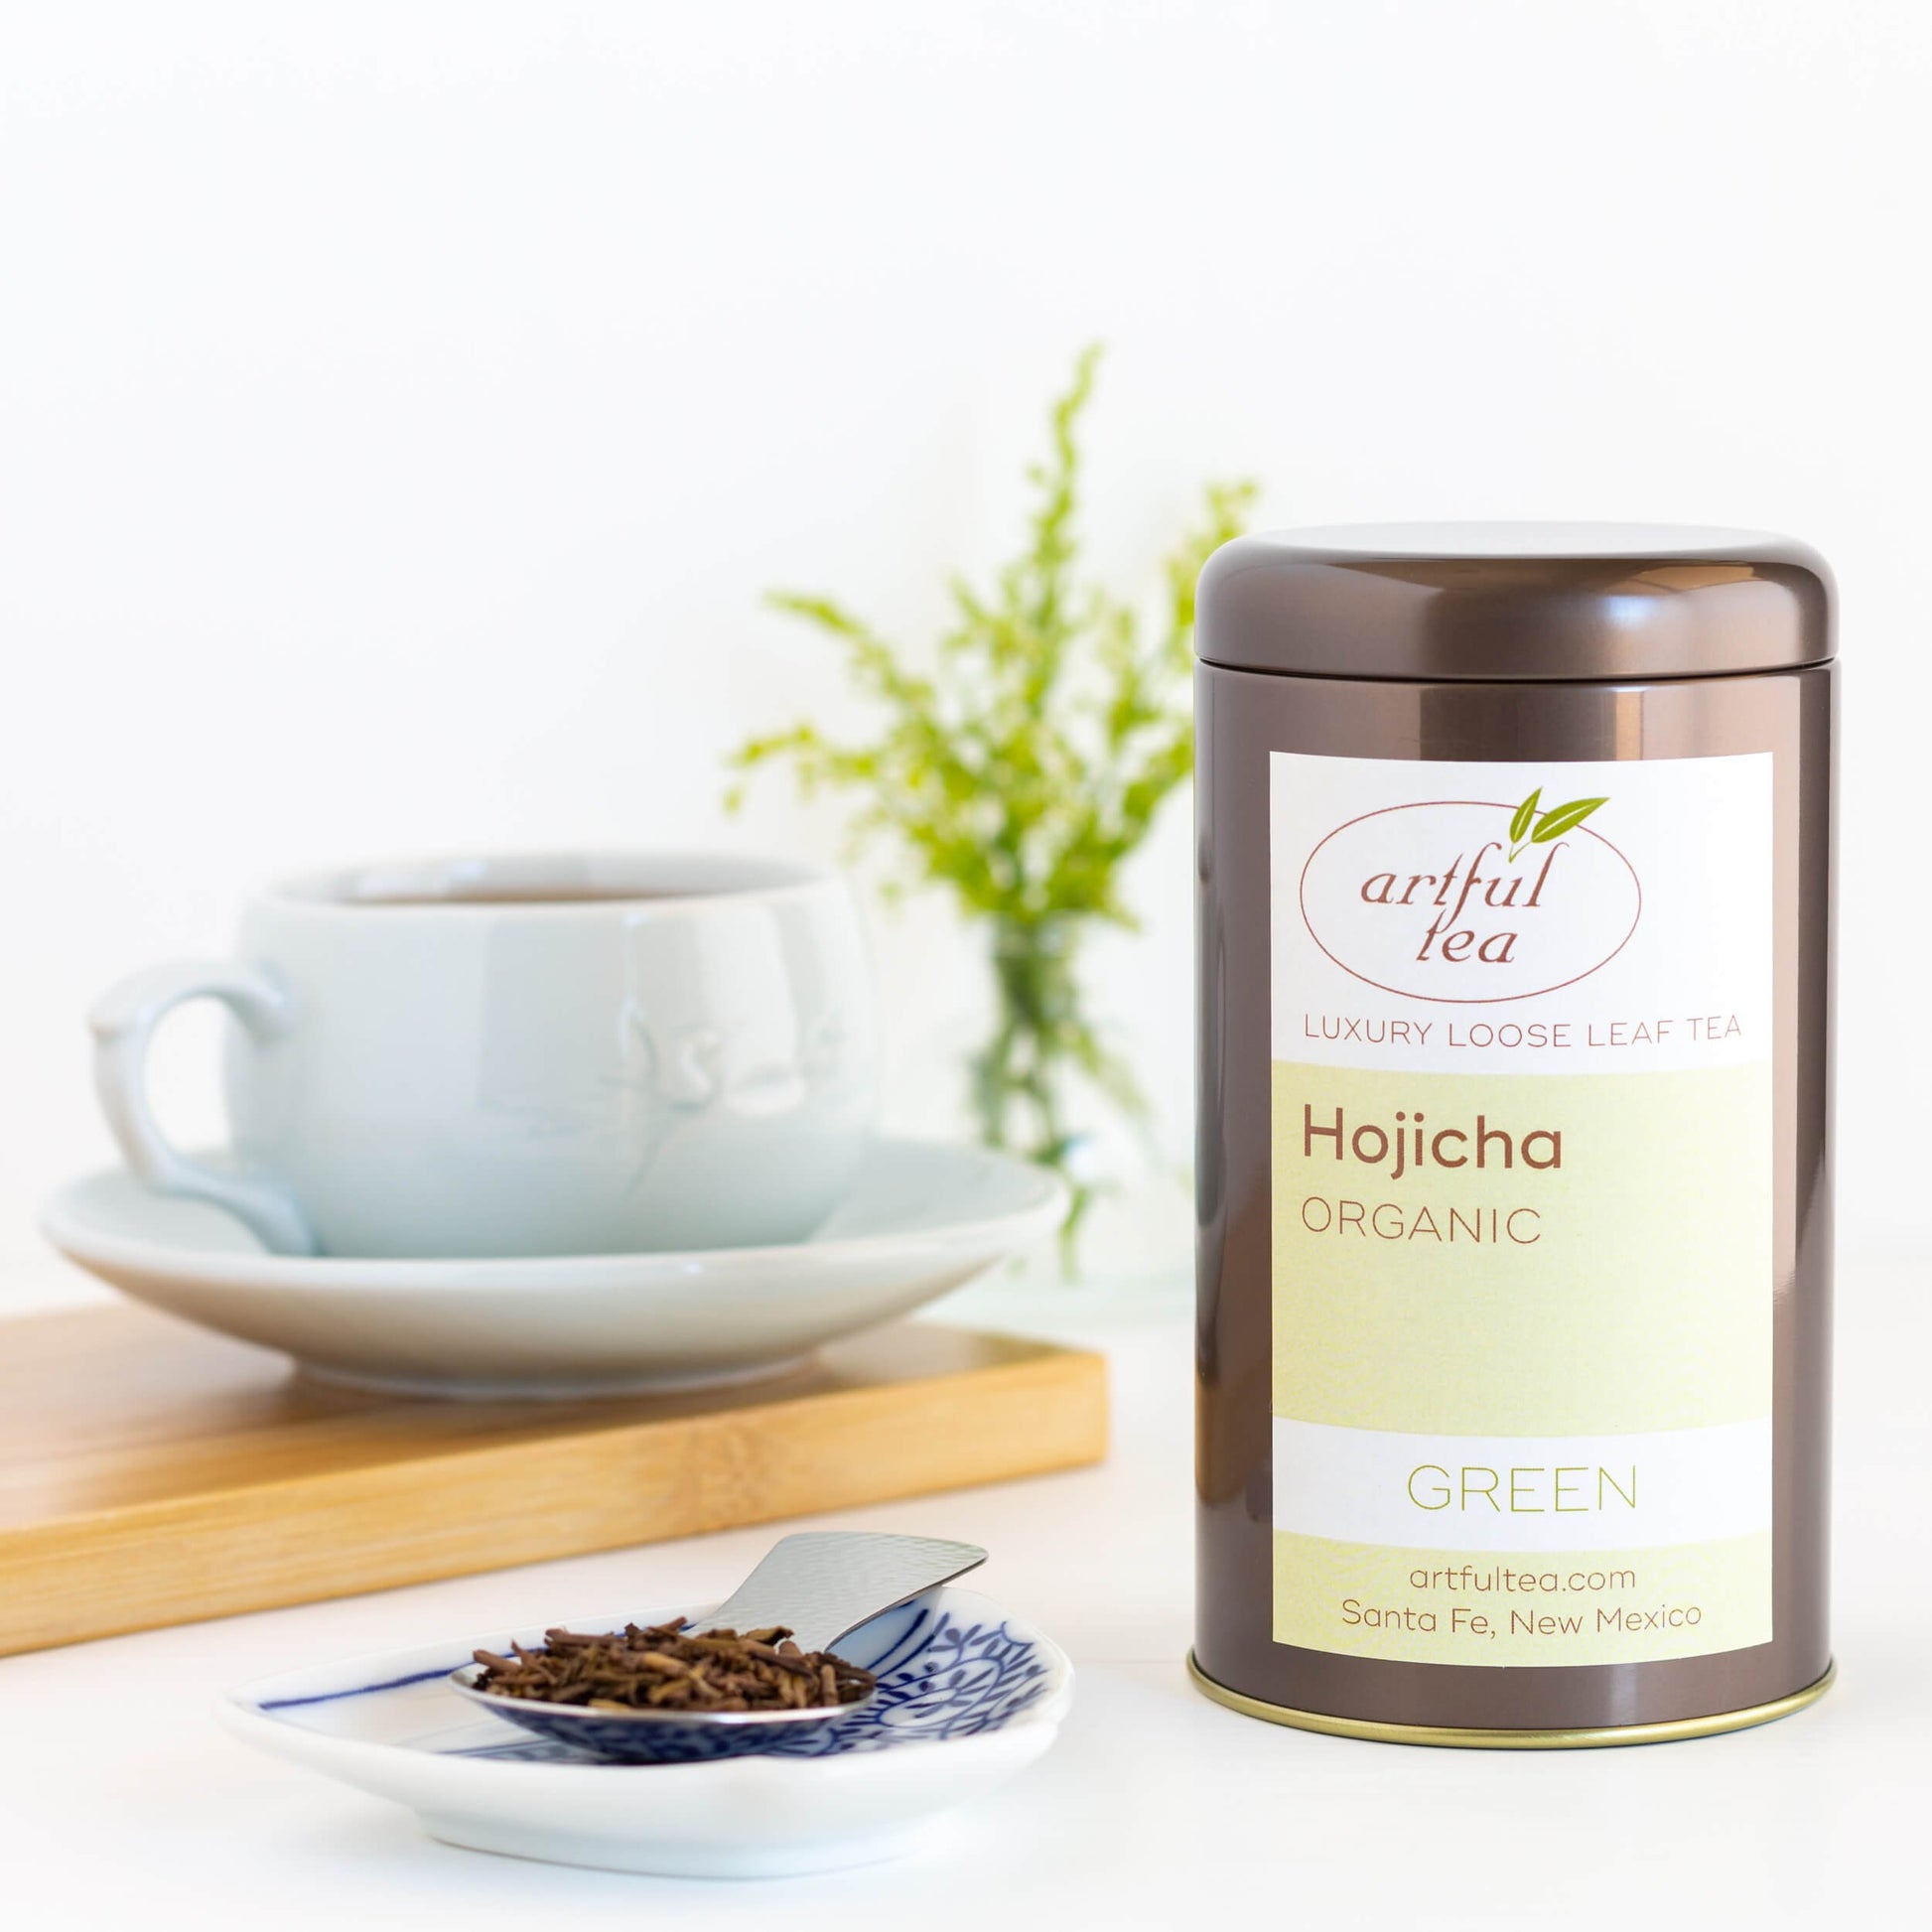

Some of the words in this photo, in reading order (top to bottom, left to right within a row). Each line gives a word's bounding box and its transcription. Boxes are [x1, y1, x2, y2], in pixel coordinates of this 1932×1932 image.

[1361, 842, 1570, 932] artful
[1416, 909, 1518, 963] tea
[1305, 1014, 1433, 1045] LUXURY
[1449, 1023, 1572, 1048] LOOSE
[1587, 1020, 1674, 1047] LEAF
[1686, 1015, 1742, 1040] TEA
[1304, 1103, 1563, 1180] Hojicha
[1302, 1196, 1542, 1245] ORGANIC
[1407, 1464, 1637, 1513] GREEN
[1409, 1565, 1636, 1592] artfultea.com
[1341, 1598, 1437, 1632] Santa
[1451, 1607, 1497, 1639] Fe,
[1510, 1609, 1584, 1635] New
[1596, 1603, 1703, 1633] Mexico
